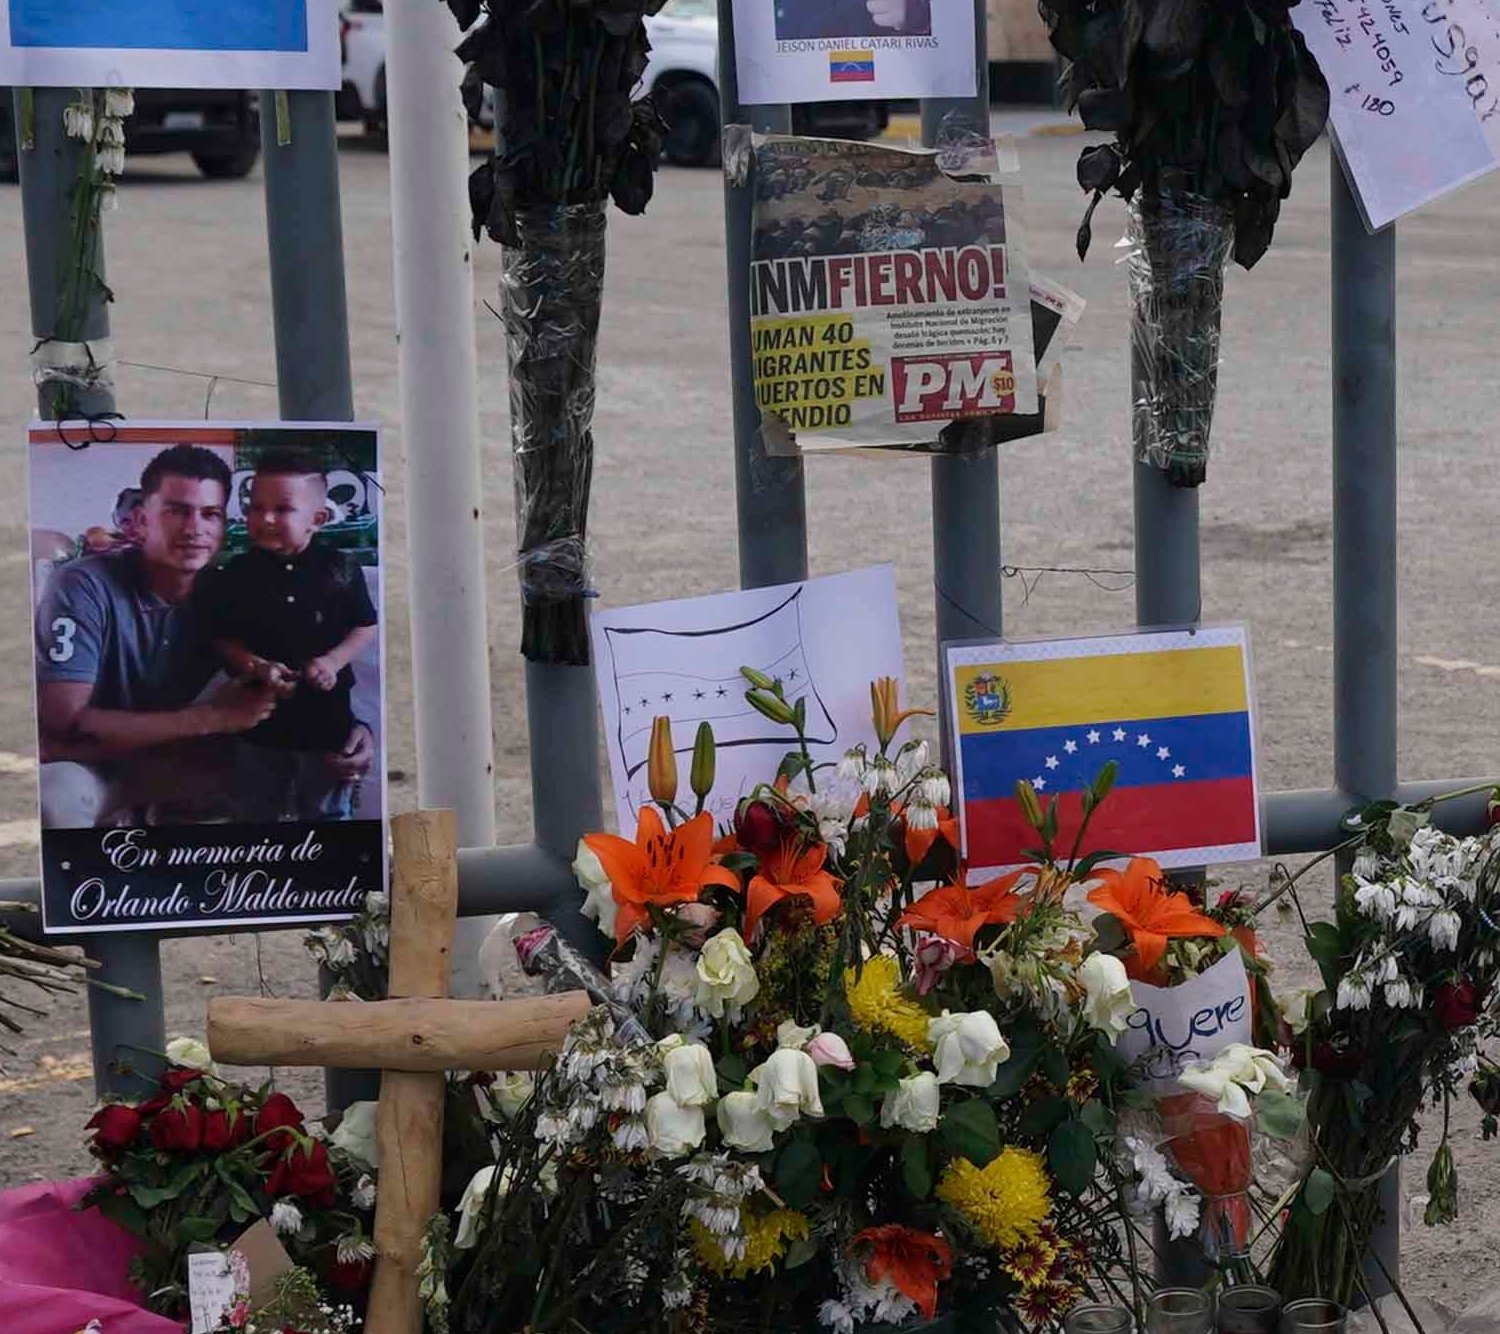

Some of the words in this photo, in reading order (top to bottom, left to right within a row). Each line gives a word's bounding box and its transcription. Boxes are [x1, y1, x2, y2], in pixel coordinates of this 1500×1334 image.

[818, 39, 859, 52] DANIEL
[821, 322, 854, 346] 40
[853, 373, 885, 397] EN
[897, 357, 1008, 414] PM
[48, 616, 77, 664] 3
[100, 828, 162, 872] En
[167, 835, 284, 869] memoria
[289, 829, 323, 865] de
[69, 877, 195, 922] Orlando
[197, 868, 367, 917] Maldonado
